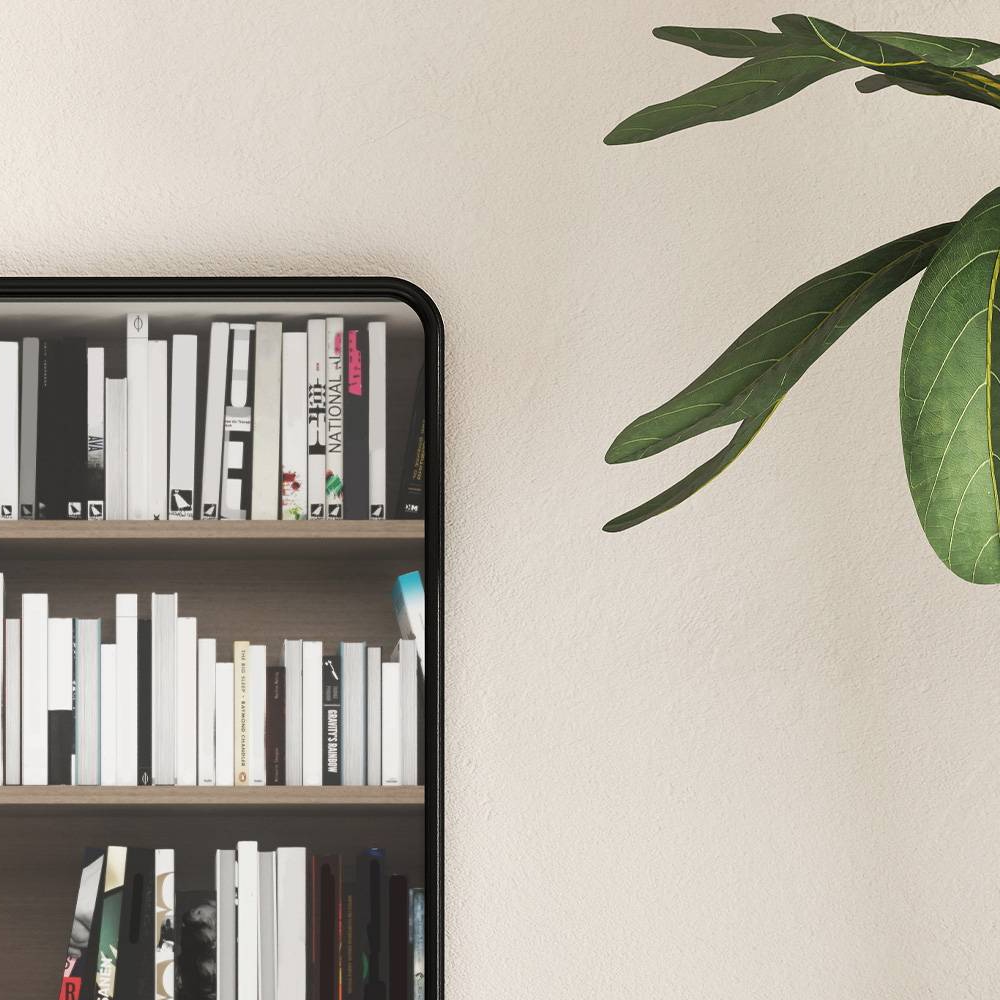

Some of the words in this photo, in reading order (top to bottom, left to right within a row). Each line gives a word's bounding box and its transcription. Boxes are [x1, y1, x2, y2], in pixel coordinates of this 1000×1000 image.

[328, 375, 342, 454] NATIONAL
[88, 435, 105, 452] AVA
[327, 709, 338, 741] GRAVITY'S
[327, 742, 338, 774] RAINBOW
